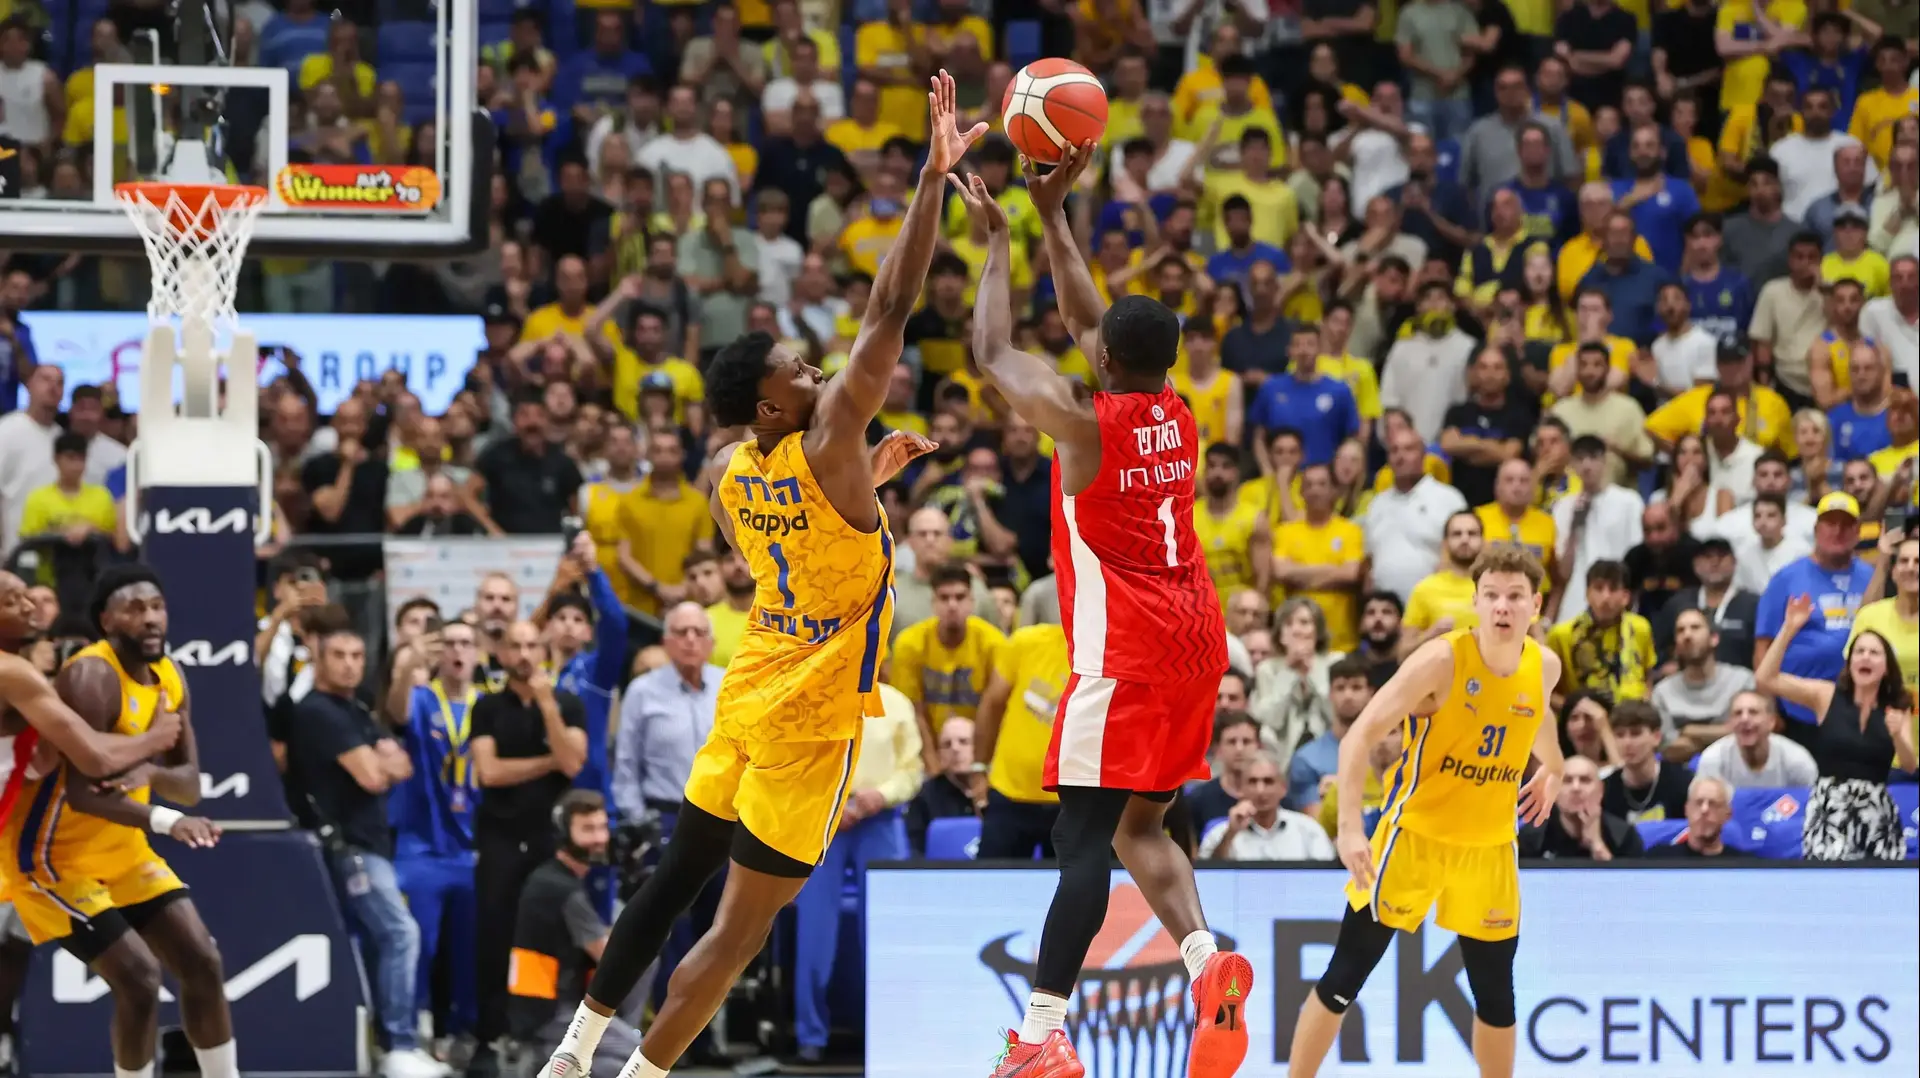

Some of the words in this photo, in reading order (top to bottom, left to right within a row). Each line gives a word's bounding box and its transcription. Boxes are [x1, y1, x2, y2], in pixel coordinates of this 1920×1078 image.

[292, 176, 394, 202] Winner
[319, 352, 446, 389] ROUP
[1119, 467, 1149, 492] חן
[155, 506, 248, 535] KIA
[738, 508, 809, 537] Rapyd
[1157, 496, 1179, 567] 1
[767, 541, 796, 609] 1
[1477, 723, 1508, 758] 31
[1526, 995, 1892, 1064] CENTERS
